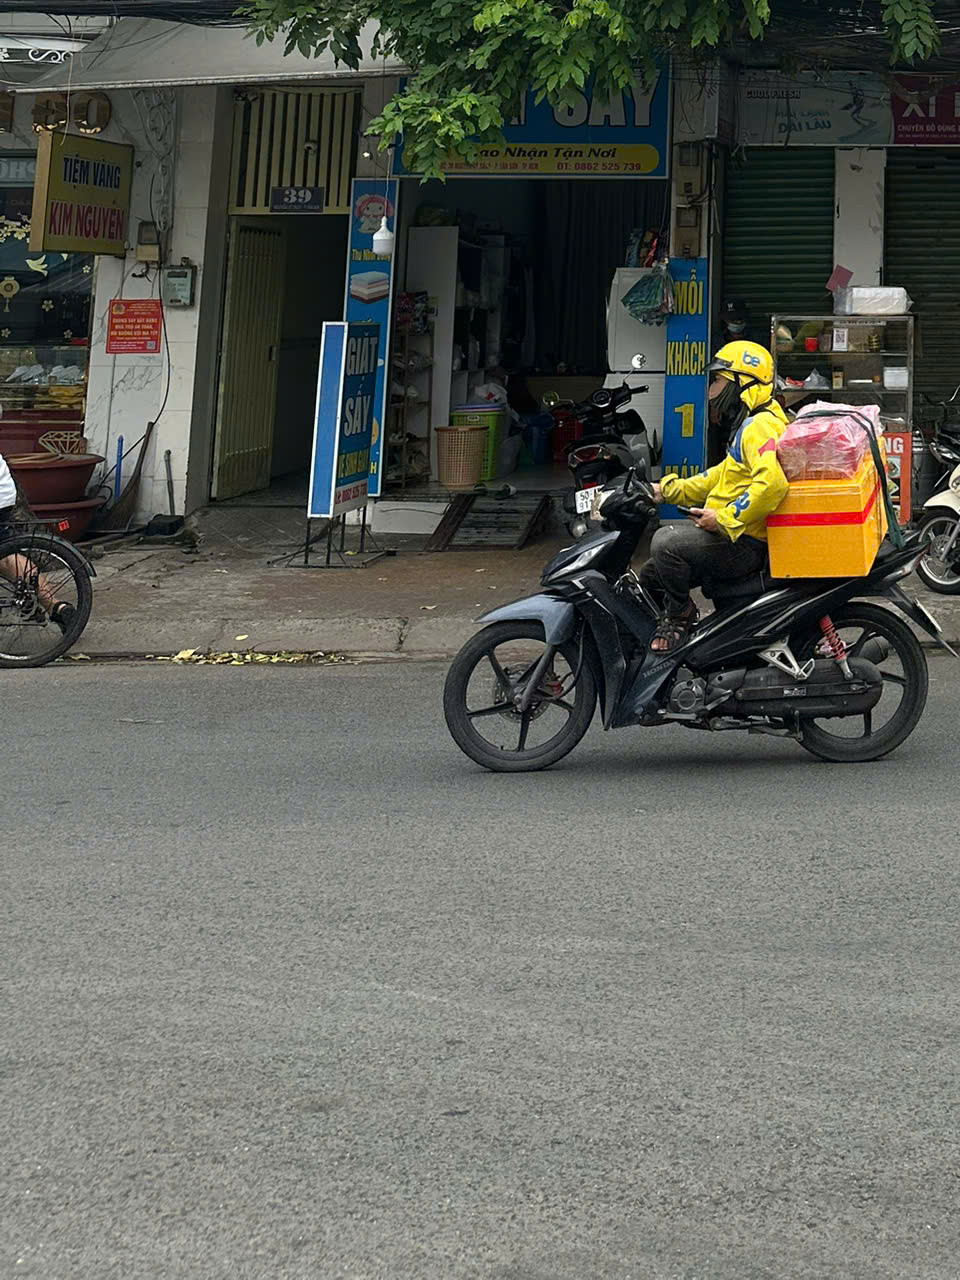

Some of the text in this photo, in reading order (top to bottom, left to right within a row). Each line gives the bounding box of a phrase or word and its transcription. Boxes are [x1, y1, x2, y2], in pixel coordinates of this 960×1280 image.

[504, 147, 618, 160] Nhận Tận Nơi
[601, 162, 620, 171] 525
[64, 154, 89, 189] TIỆM
[93, 158, 121, 189] VÀNG
[283, 188, 312, 204] 39
[48, 201, 74, 236] KIM
[673, 268, 704, 315] MỖI
[346, 333, 378, 381] GIẶT
[666, 333, 706, 376] KHÁCH
[744, 350, 760, 367] be
[343, 383, 372, 438] SẤY
[674, 403, 694, 437] 1
[641, 658, 676, 679] HONDA
